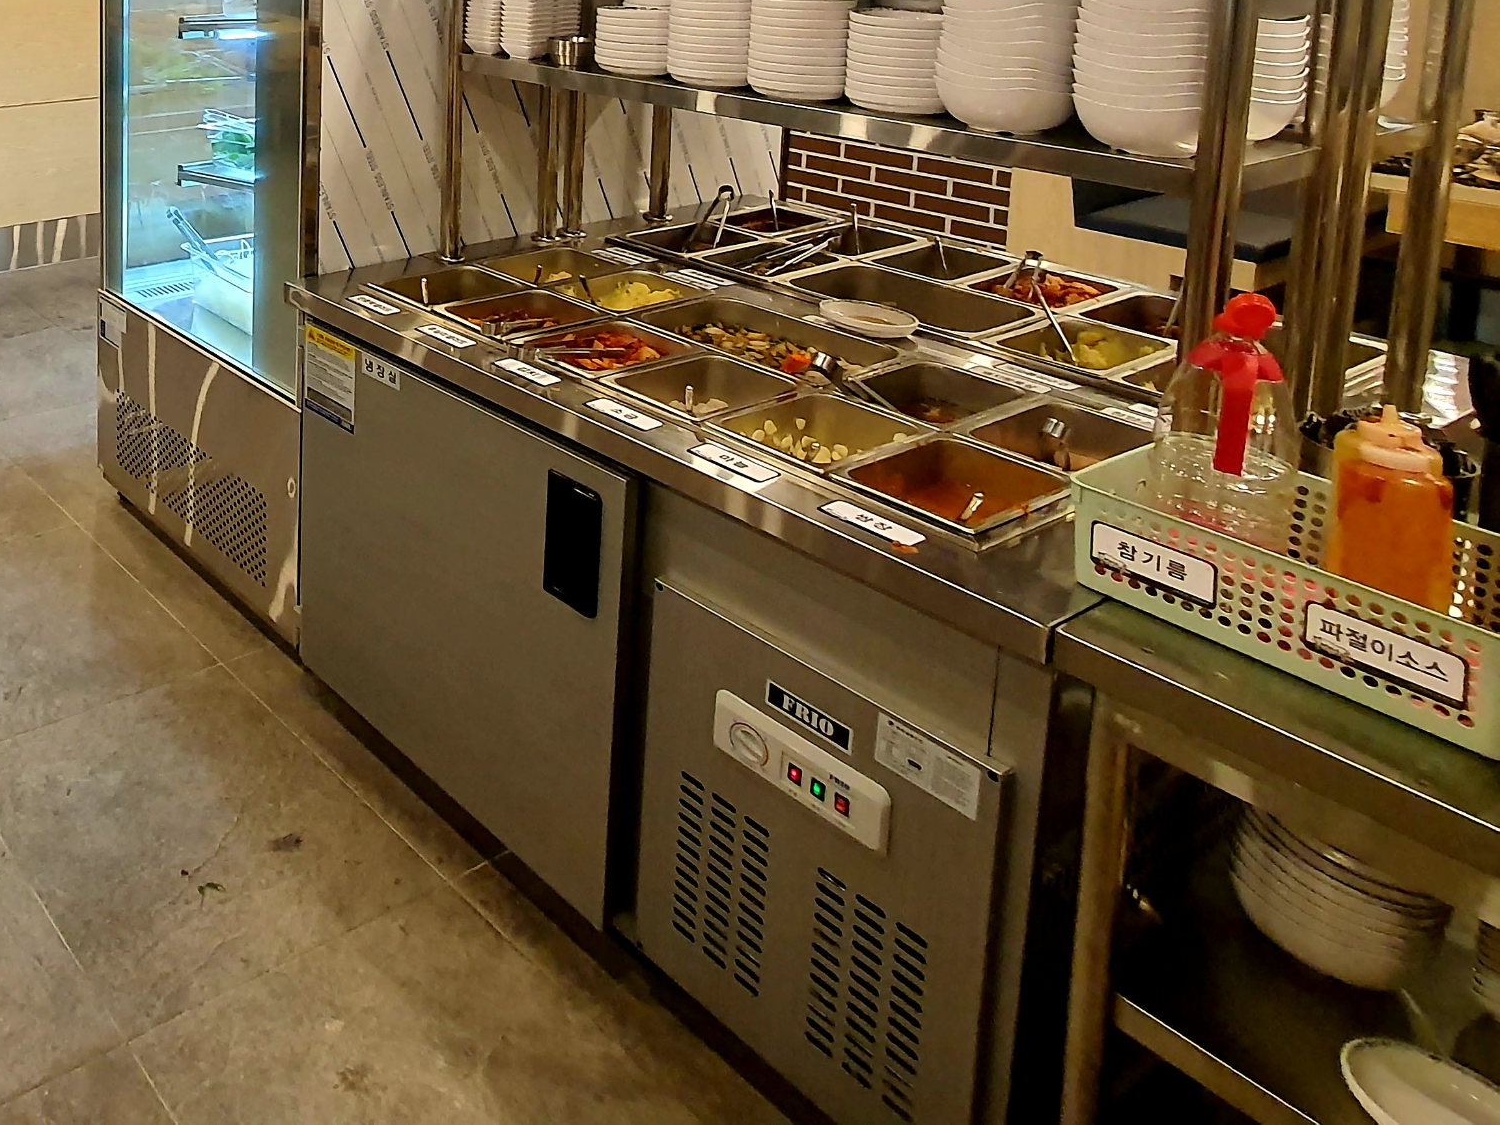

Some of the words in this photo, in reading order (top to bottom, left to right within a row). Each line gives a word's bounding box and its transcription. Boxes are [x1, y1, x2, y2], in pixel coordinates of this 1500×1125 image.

[364, 358, 397, 384] 냉장실
[719, 453, 749, 469] 마늘
[1117, 539, 1189, 582] 참기름
[1319, 617, 1450, 683] 파절이소스
[783, 693, 834, 736] FRIO
